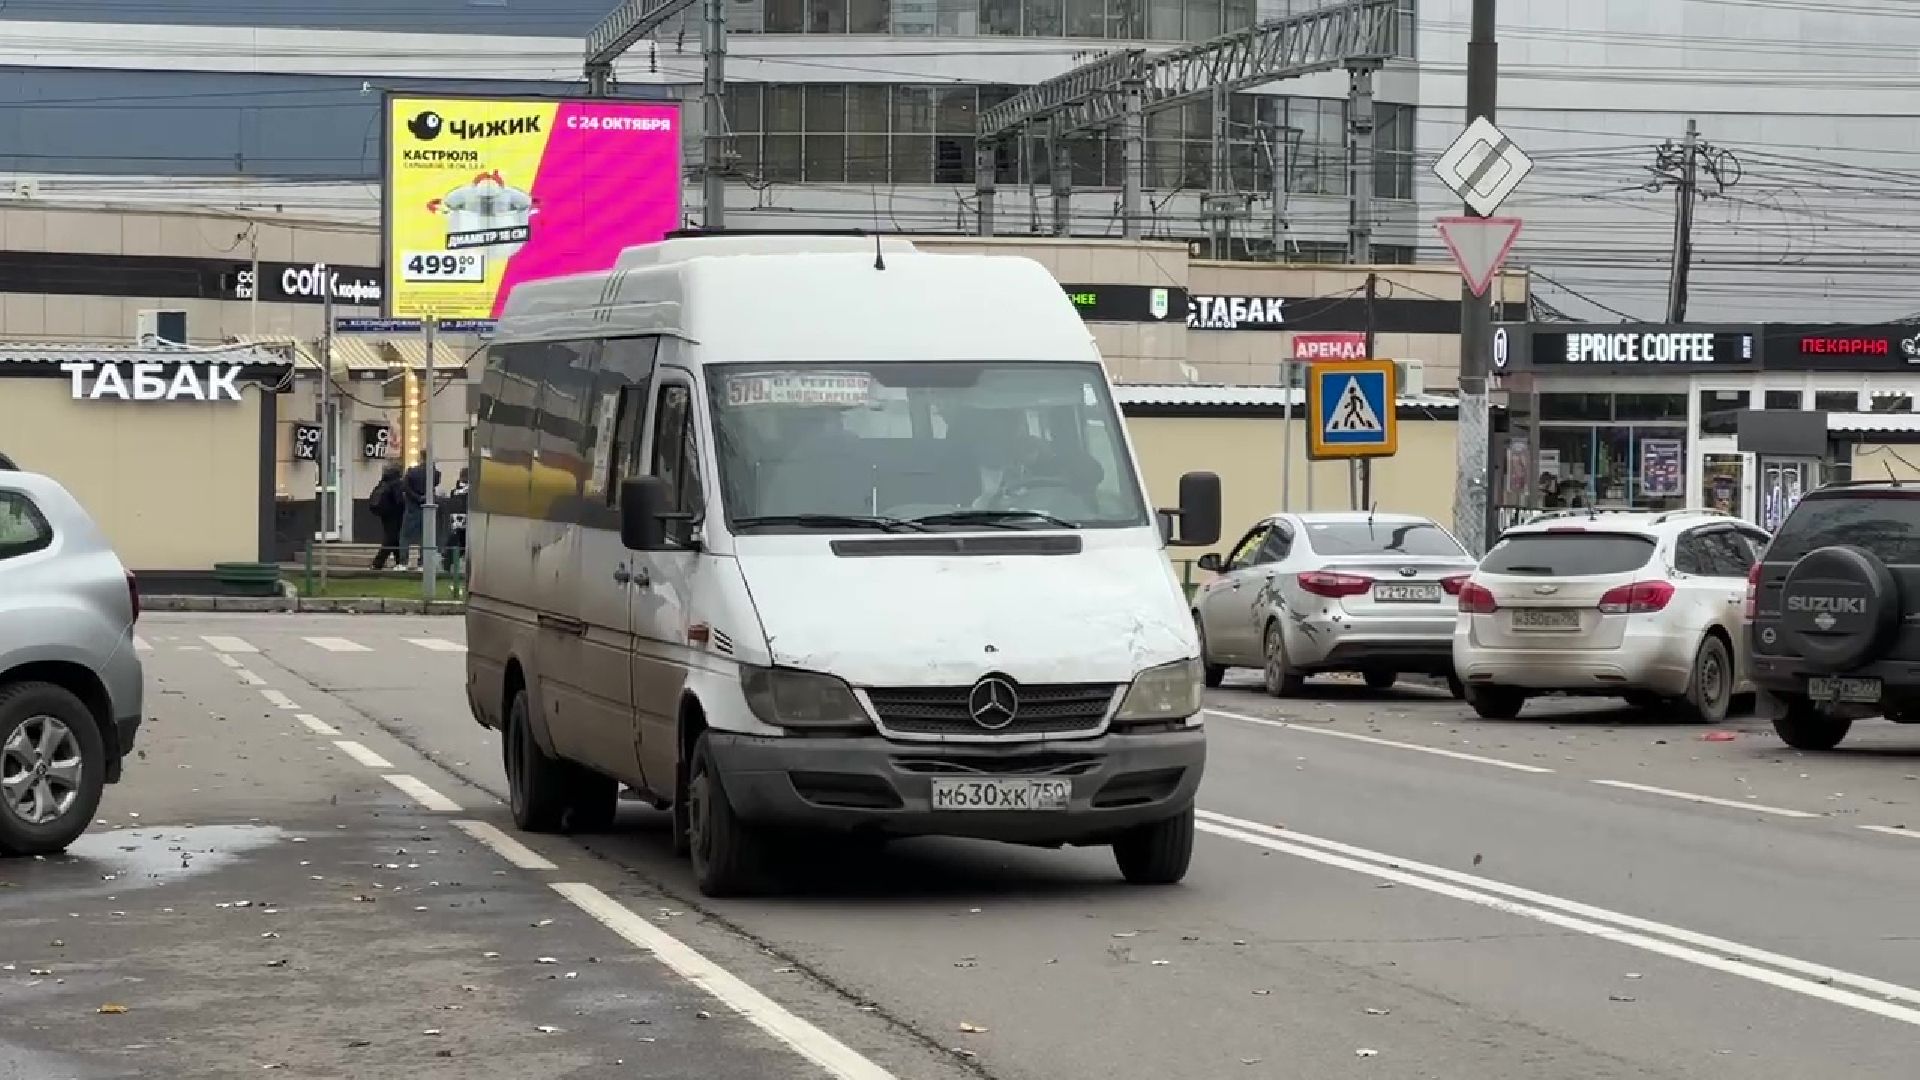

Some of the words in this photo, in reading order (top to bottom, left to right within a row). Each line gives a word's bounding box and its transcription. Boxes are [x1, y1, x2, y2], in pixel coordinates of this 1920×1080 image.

[450, 115, 541, 139] Чижик
[567, 116, 577, 129] С
[579, 116, 598, 130] 24
[602, 117, 671, 131] ОКТЯБРЯ
[403, 150, 478, 161] КАСТРЮЛЯ
[448, 231, 497, 248] ДИАМЕТР
[408, 255, 457, 274] 499
[1197, 296, 1285, 323] ТАБАК
[1297, 342, 1366, 358] АРЕНДА
[1581, 333, 1639, 362] PRICE
[1642, 333, 1714, 362] COFFEE
[1802, 338, 1888, 354] ПЕКАРНЯ
[60, 363, 244, 400] ТАБАК
[1788, 596, 1867, 613] SUZUKI
[938, 783, 1027, 806] М630ХК
[1031, 782, 1066, 800] 750
